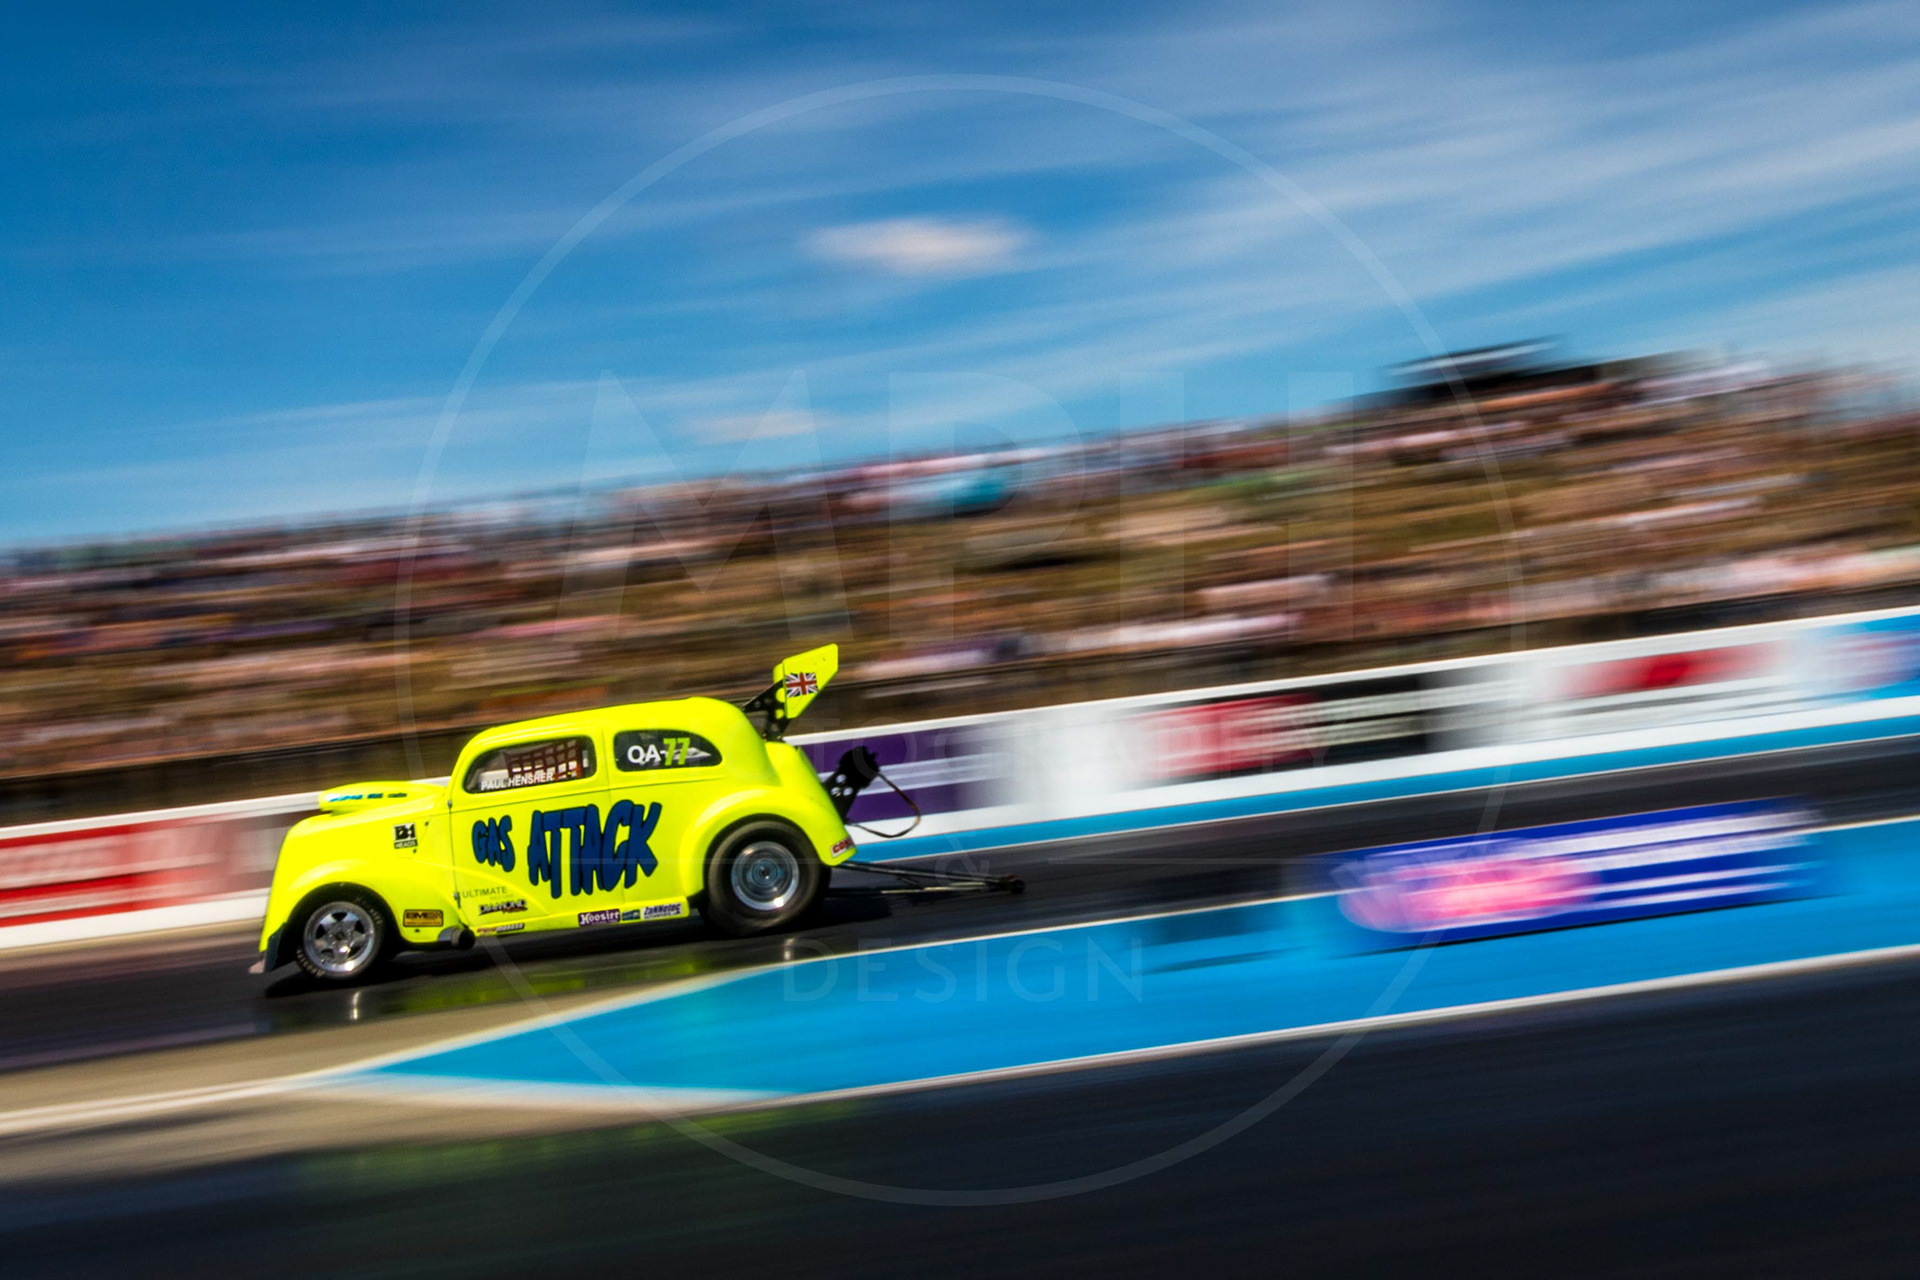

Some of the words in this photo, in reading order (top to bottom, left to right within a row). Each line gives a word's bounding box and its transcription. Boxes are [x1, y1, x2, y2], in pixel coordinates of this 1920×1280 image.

[480, 779, 507, 791] PAUL
[508, 772, 555, 788] HENSHER
[472, 815, 516, 872] GAS
[527, 799, 662, 899] ATTACK
[462, 886, 508, 899] ULTIMATE
